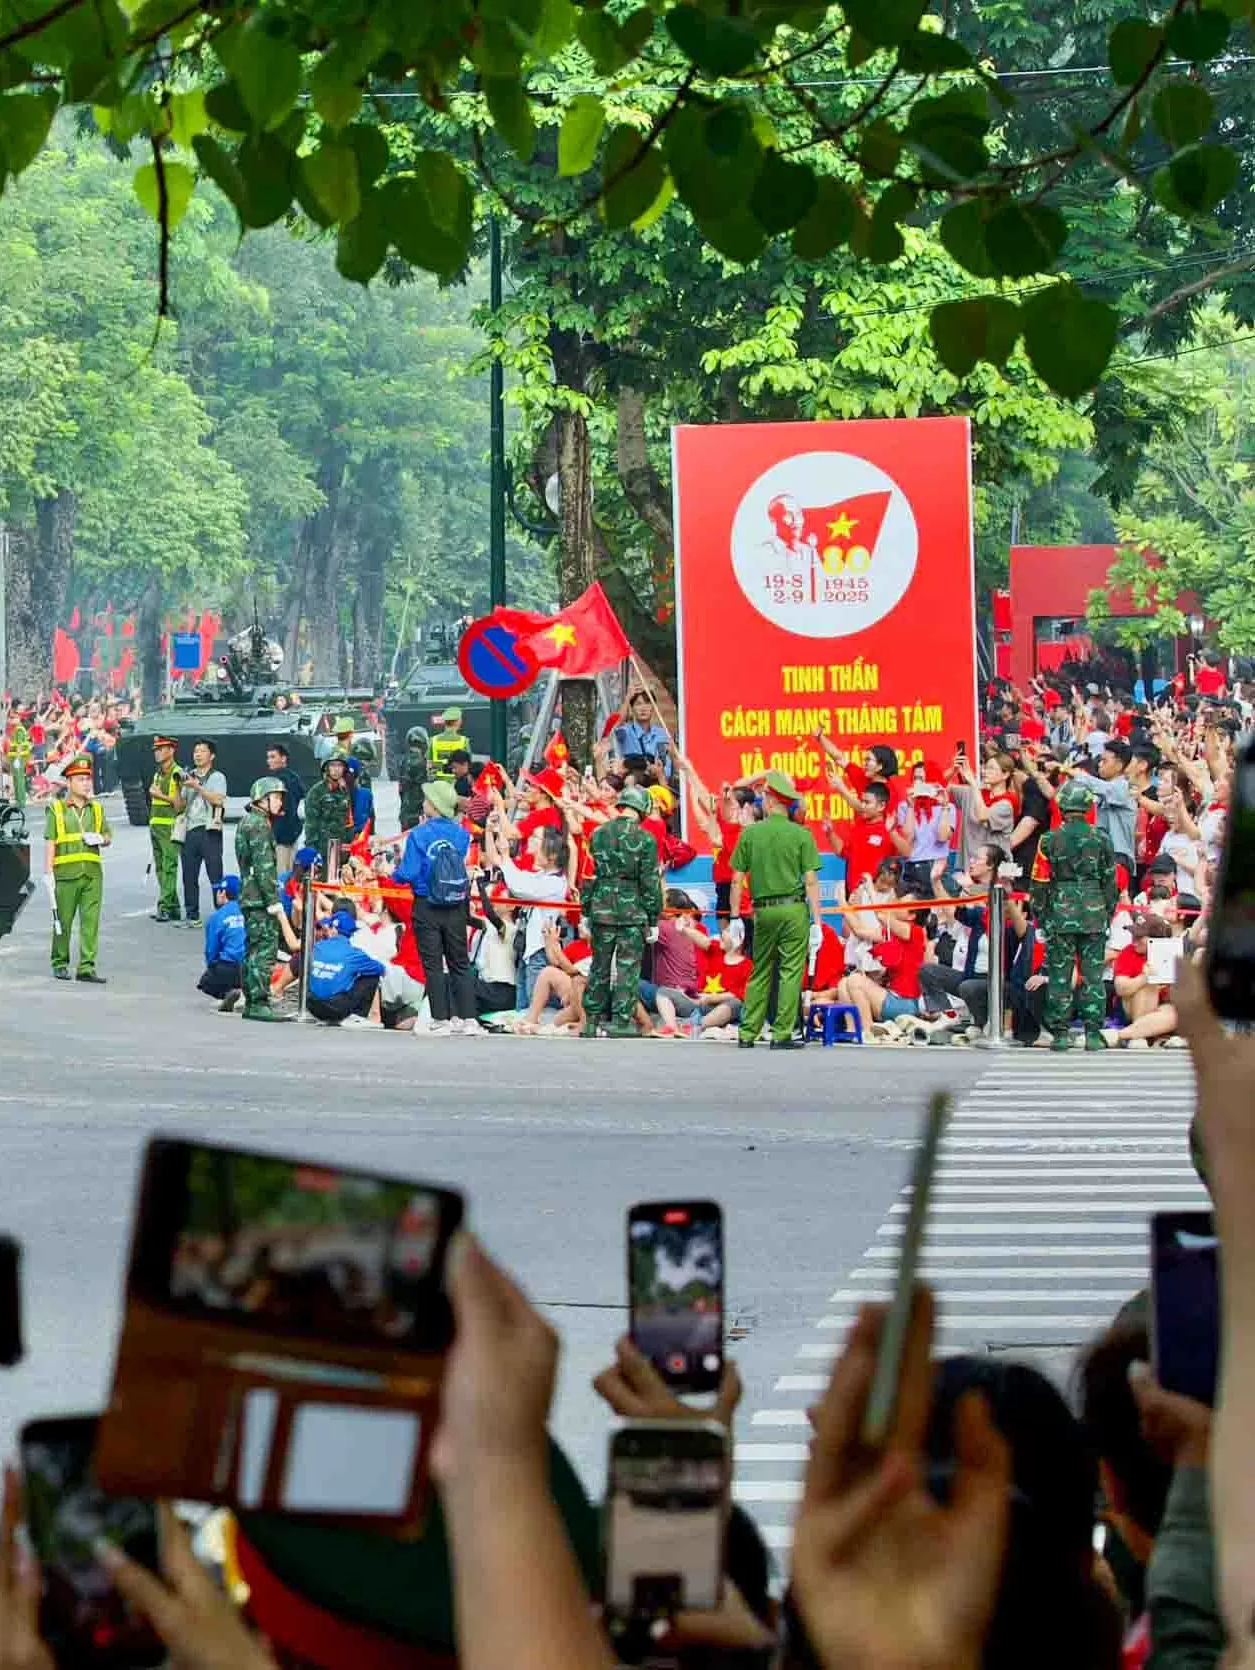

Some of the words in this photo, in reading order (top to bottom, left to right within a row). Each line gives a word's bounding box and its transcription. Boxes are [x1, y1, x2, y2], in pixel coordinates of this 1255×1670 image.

[823, 545, 871, 575] 80
[825, 577, 869, 589] 1945
[825, 590, 869, 602] 2025
[782, 665, 825, 693] TINH
[720, 705, 770, 737] CÁCH
[835, 702, 897, 734] THÁNG
[902, 699, 943, 732] TÁM
